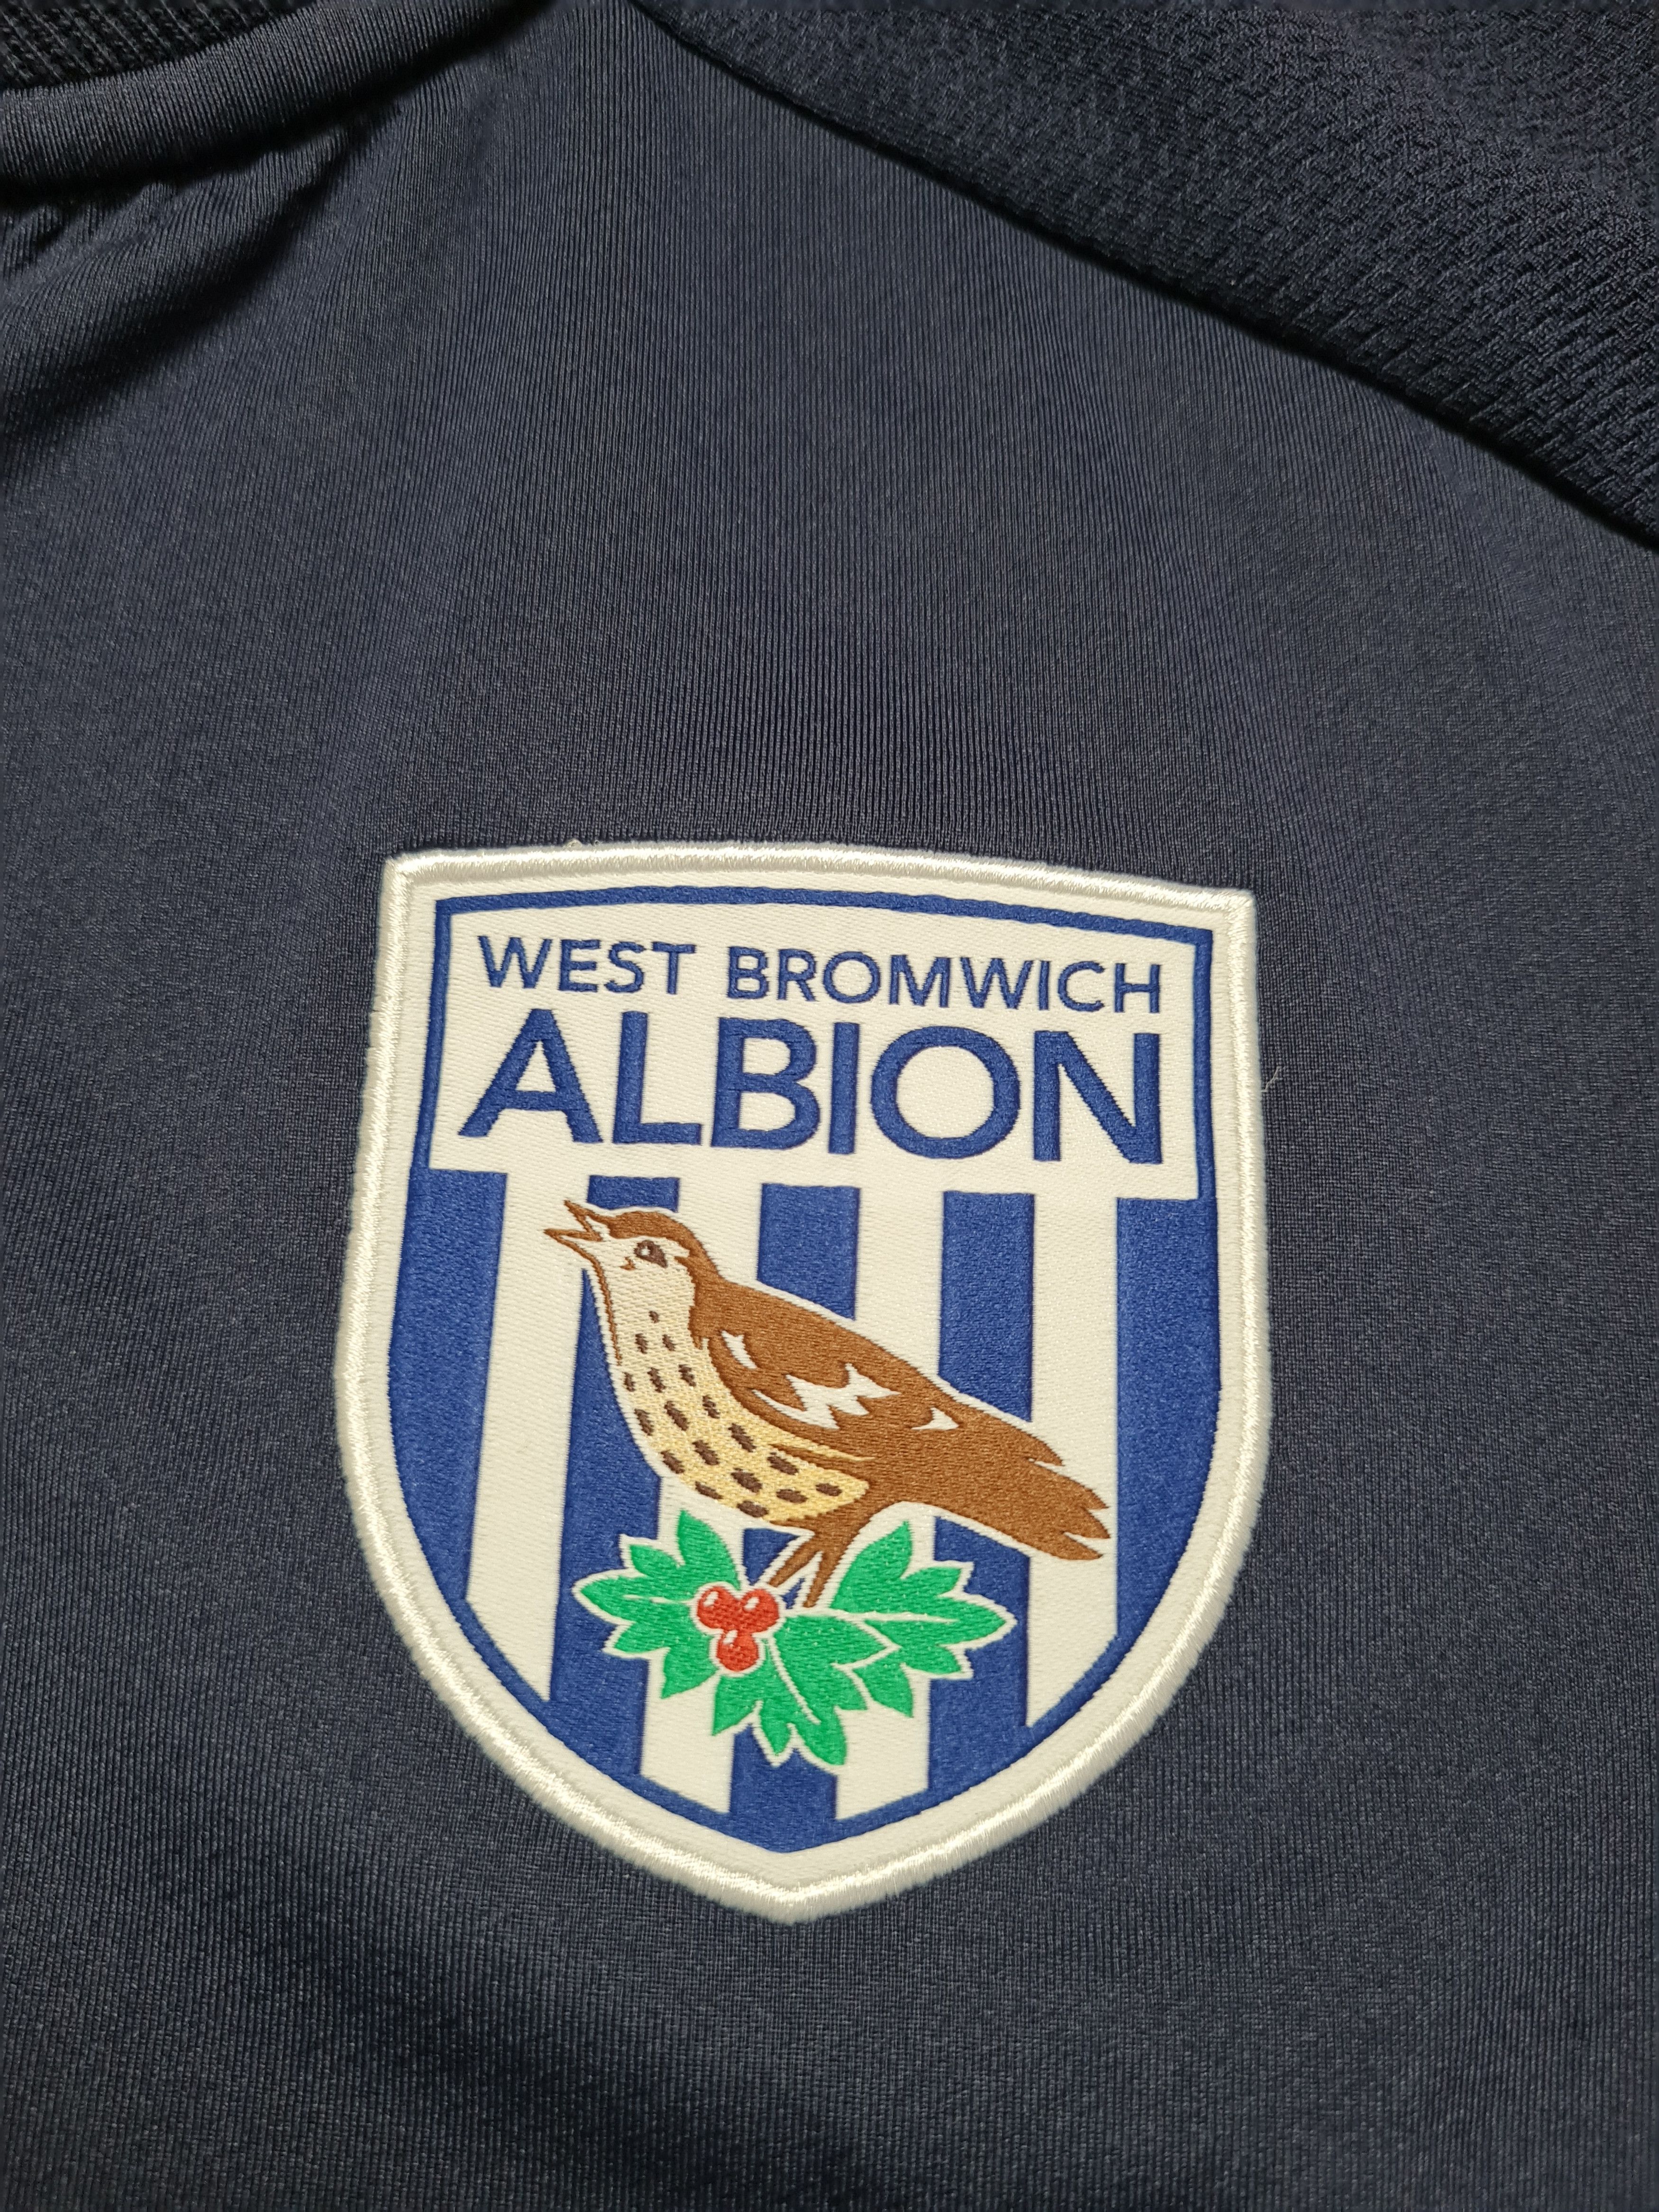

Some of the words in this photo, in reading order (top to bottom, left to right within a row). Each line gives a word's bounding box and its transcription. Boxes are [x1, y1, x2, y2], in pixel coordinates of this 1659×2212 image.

[477, 935, 696, 995] WEST
[727, 947, 1161, 1013] BROMWICH
[458, 1009, 1163, 1165] ALBION
